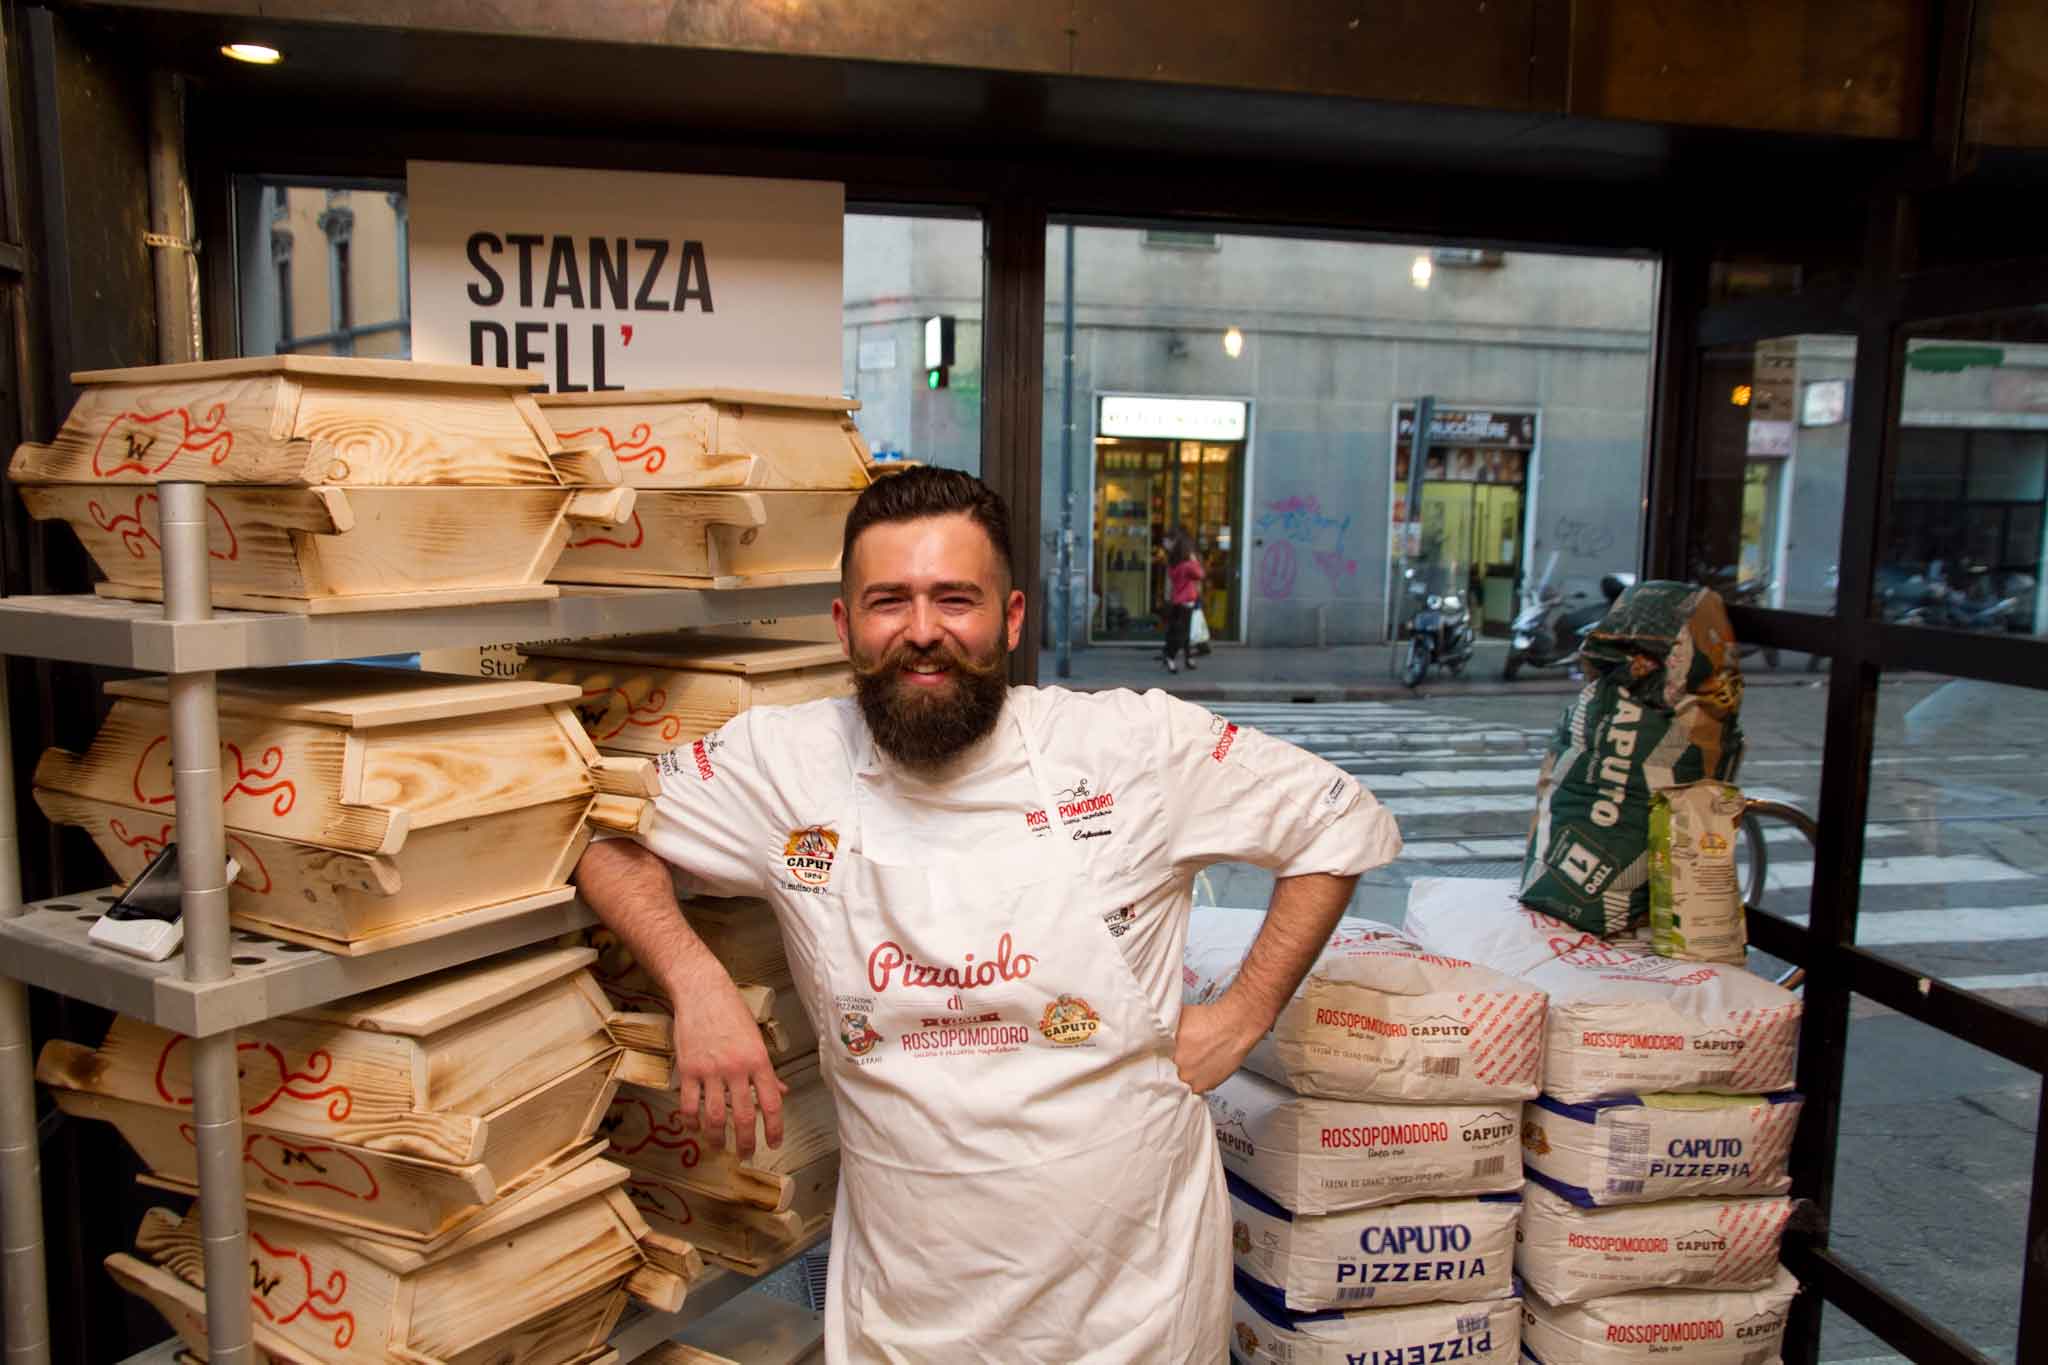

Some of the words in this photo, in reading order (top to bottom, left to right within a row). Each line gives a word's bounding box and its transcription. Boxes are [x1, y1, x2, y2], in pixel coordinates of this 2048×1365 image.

[466, 232, 714, 313] STANZA
[469, 320, 634, 394] DELL'
[786, 857, 833, 871] CAPUT
[1585, 863, 1613, 895] TIPO
[868, 932, 1038, 993] Pizzaiolo
[947, 993, 963, 1010] di
[1044, 1021, 1097, 1037] CAPUTO
[1316, 1007, 1408, 1038] ROSSOPOMODORO
[1411, 1025, 1470, 1037] CAPUTO
[901, 1026, 1029, 1051] ROSSOPOMODORO
[1582, 1031, 1685, 1051] ROSSOPOMODORO
[1693, 1040, 1746, 1050] CAPUTO
[1216, 1129, 1255, 1157] CAPUTO
[1321, 1121, 1449, 1149] ROSSOPOMODORO
[1462, 1124, 1515, 1142] CAPUTO
[1668, 1138, 1743, 1159] CAPUTO
[1649, 1160, 1751, 1178] PIZZERIA
[1360, 1224, 1471, 1255] CAPUTO
[1567, 1232, 1669, 1252] ROSSOPOMODORO
[1675, 1240, 1726, 1251] CAPUTO
[1336, 1258, 1486, 1283] PIZZERIA
[1605, 1319, 1725, 1343] ROSSOPOMODORO
[1345, 1331, 1492, 1365] PIZZERIA
